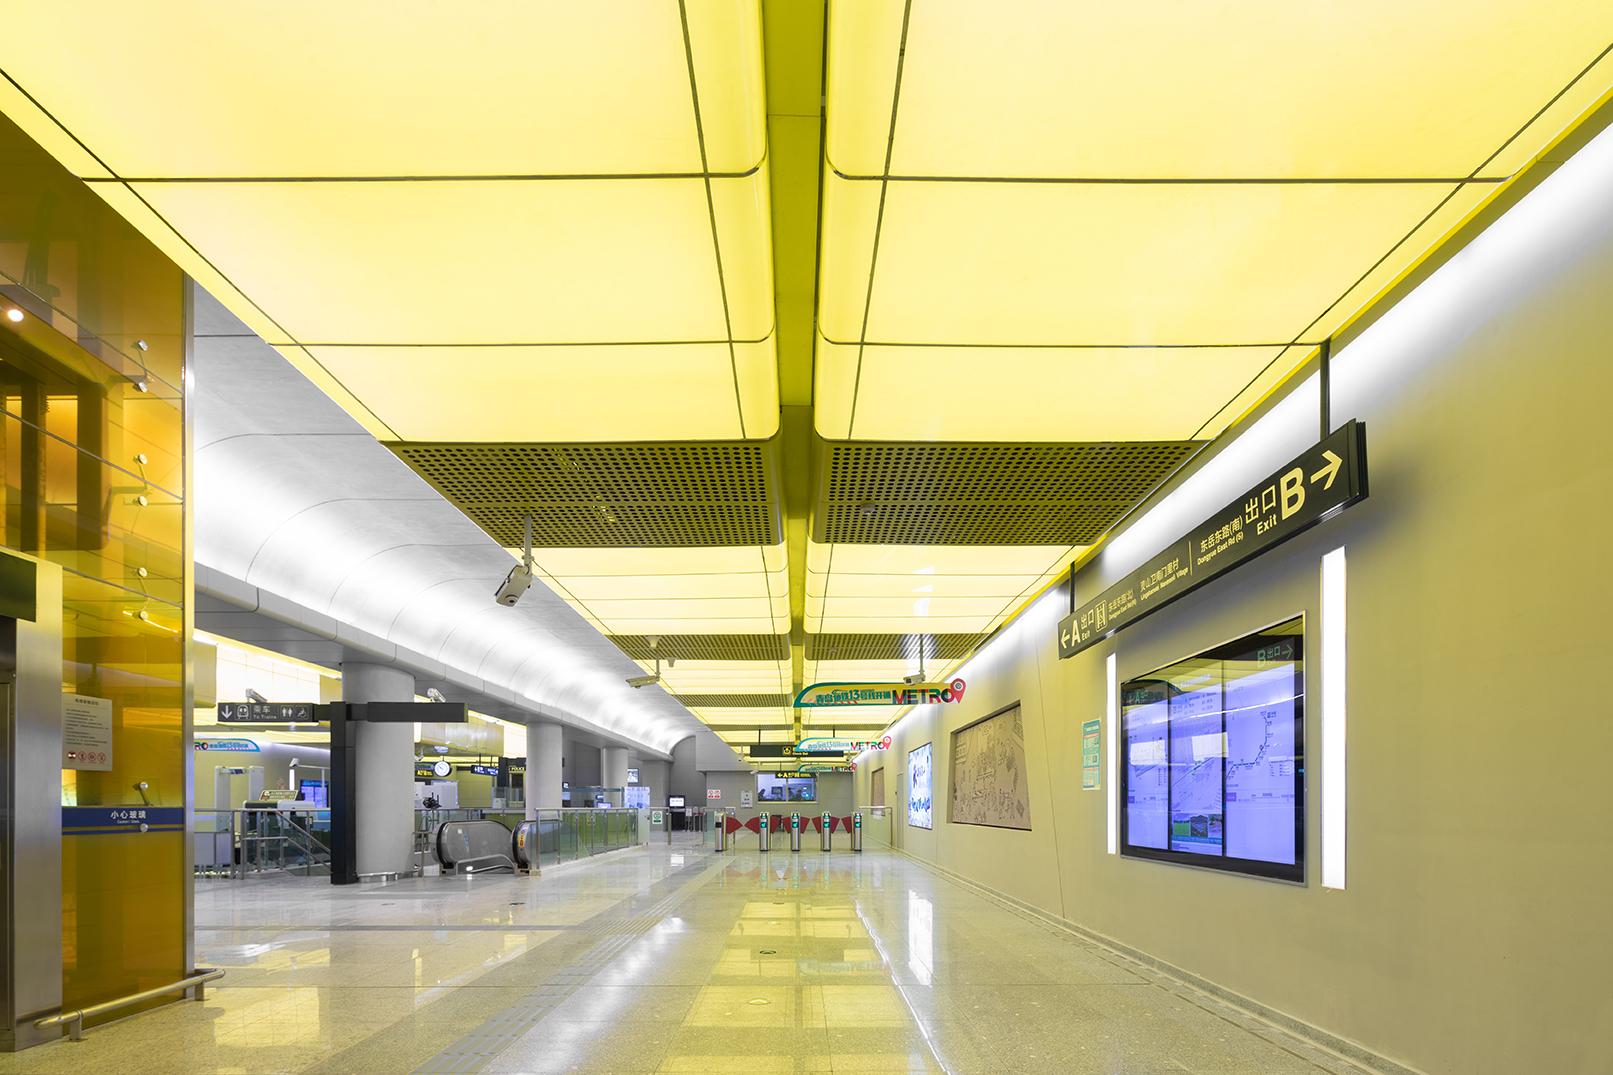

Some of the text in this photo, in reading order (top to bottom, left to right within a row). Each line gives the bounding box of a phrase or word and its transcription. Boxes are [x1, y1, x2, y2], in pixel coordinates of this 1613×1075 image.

[1245, 485, 1277, 525] 出口
[1280, 467, 1306, 521] B
[1257, 514, 1277, 536] Exit
[1080, 608, 1095, 630] 出口
[1071, 619, 1081, 647] A
[1081, 630, 1091, 641] Exit
[892, 688, 953, 705] METRO
